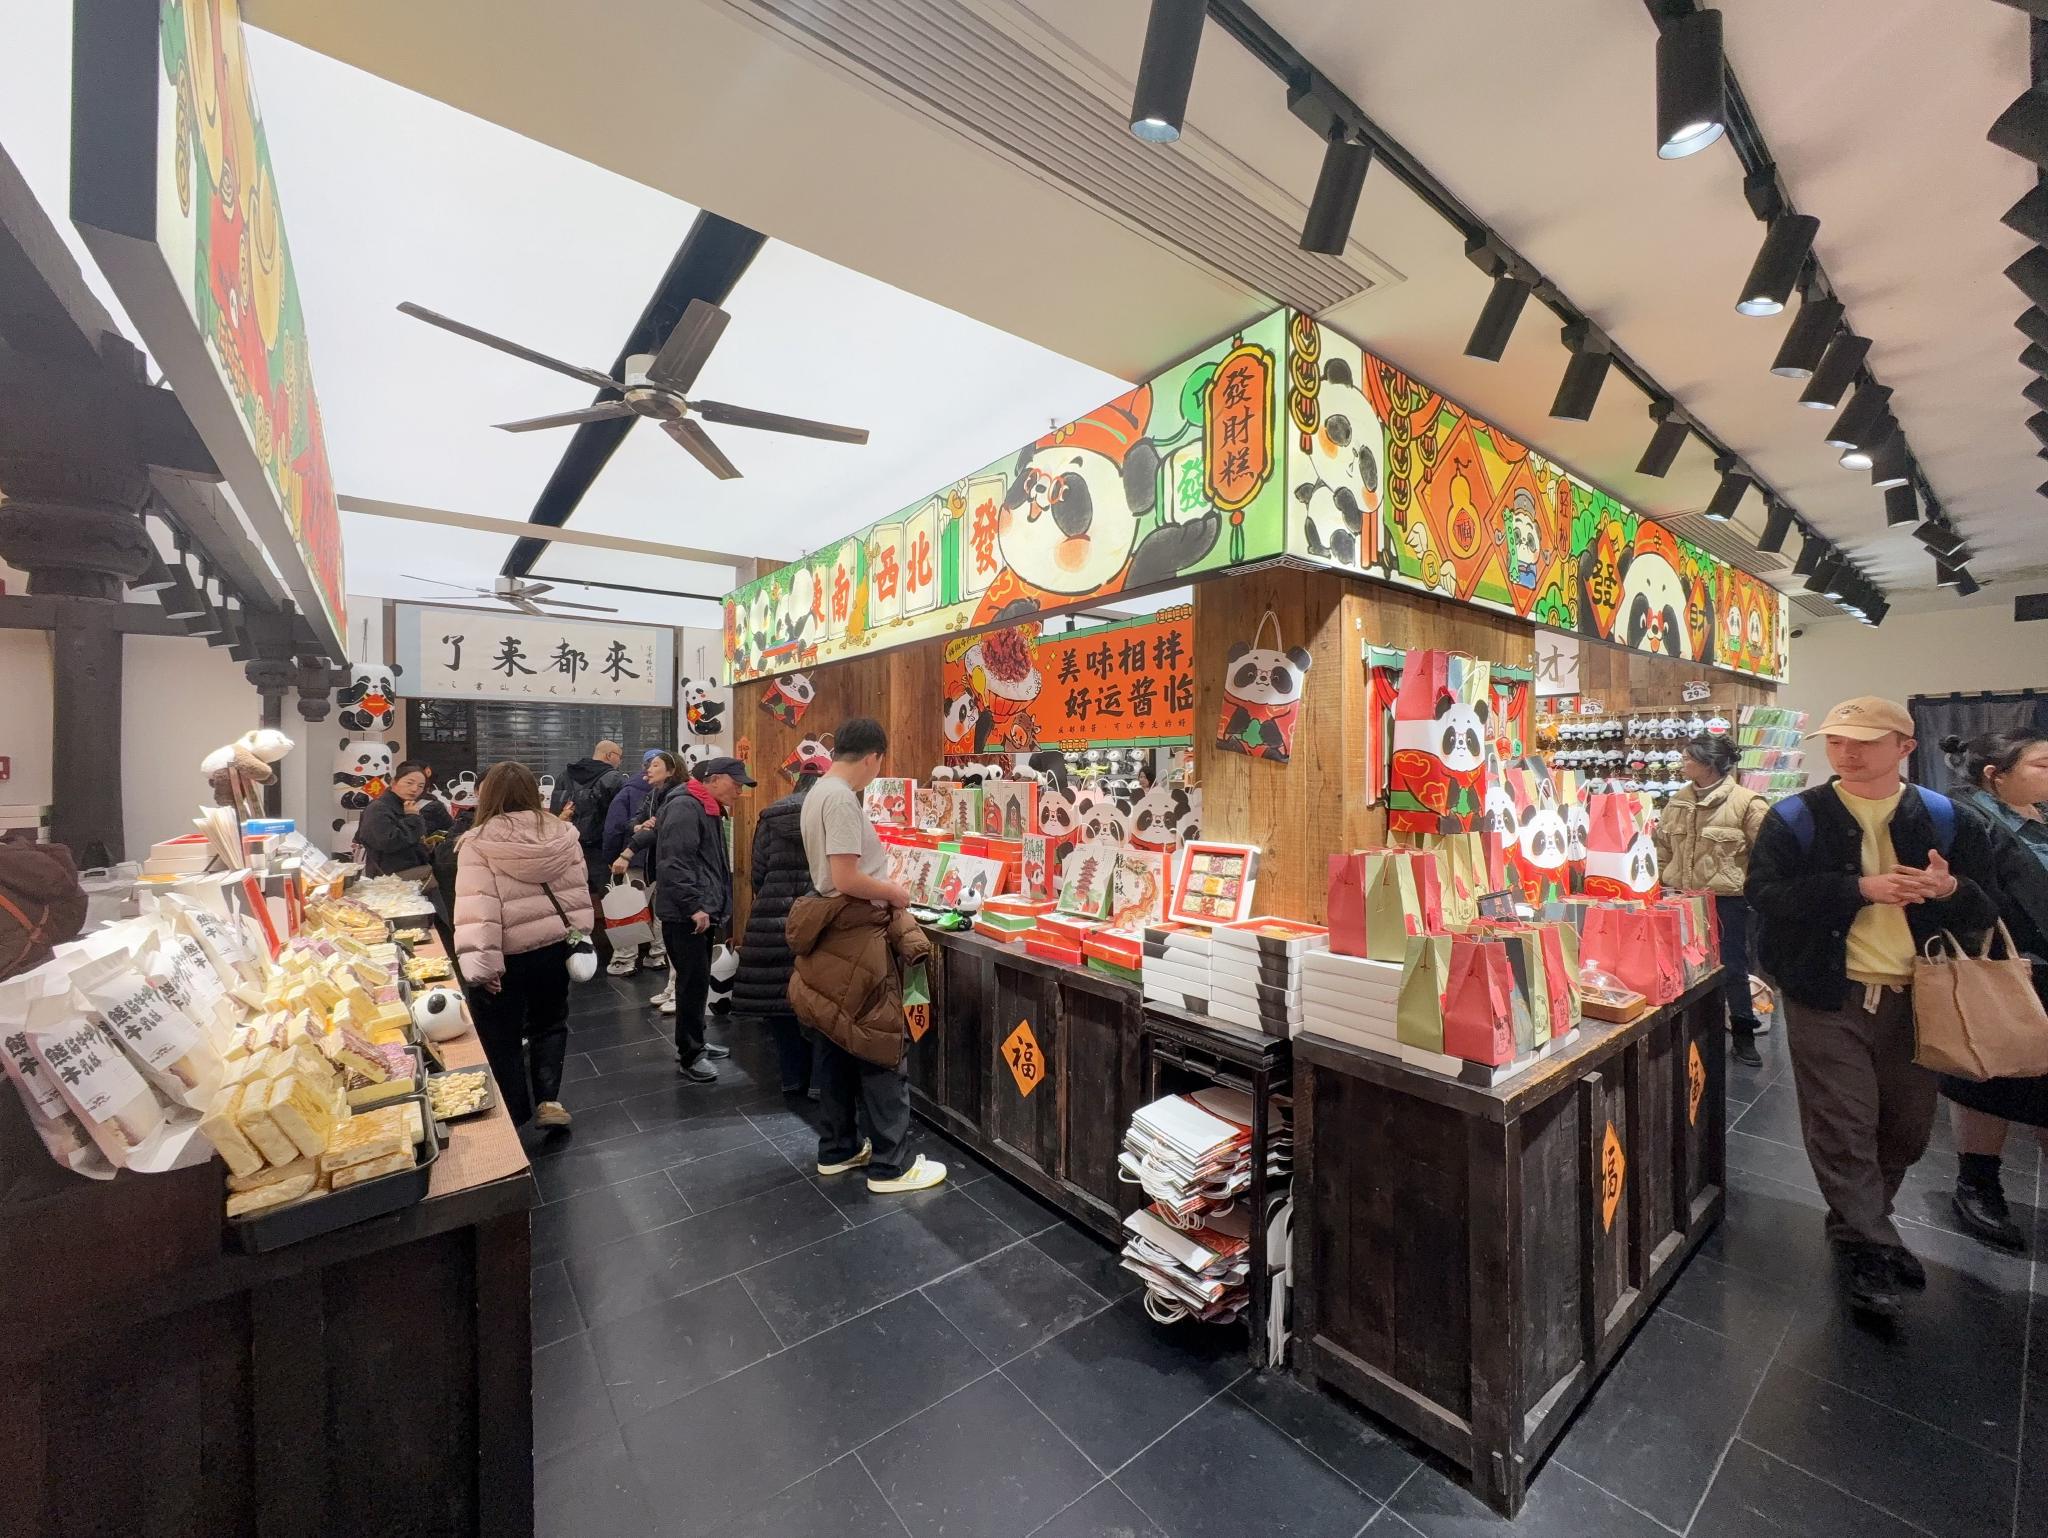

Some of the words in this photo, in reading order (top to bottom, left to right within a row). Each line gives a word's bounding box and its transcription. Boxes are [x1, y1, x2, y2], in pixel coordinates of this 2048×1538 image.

[1218, 366, 1256, 488] 發財糕
[970, 497, 999, 576] 發
[1058, 629, 1185, 686] 美味相拌
[1011, 1035, 1037, 1081] 福
